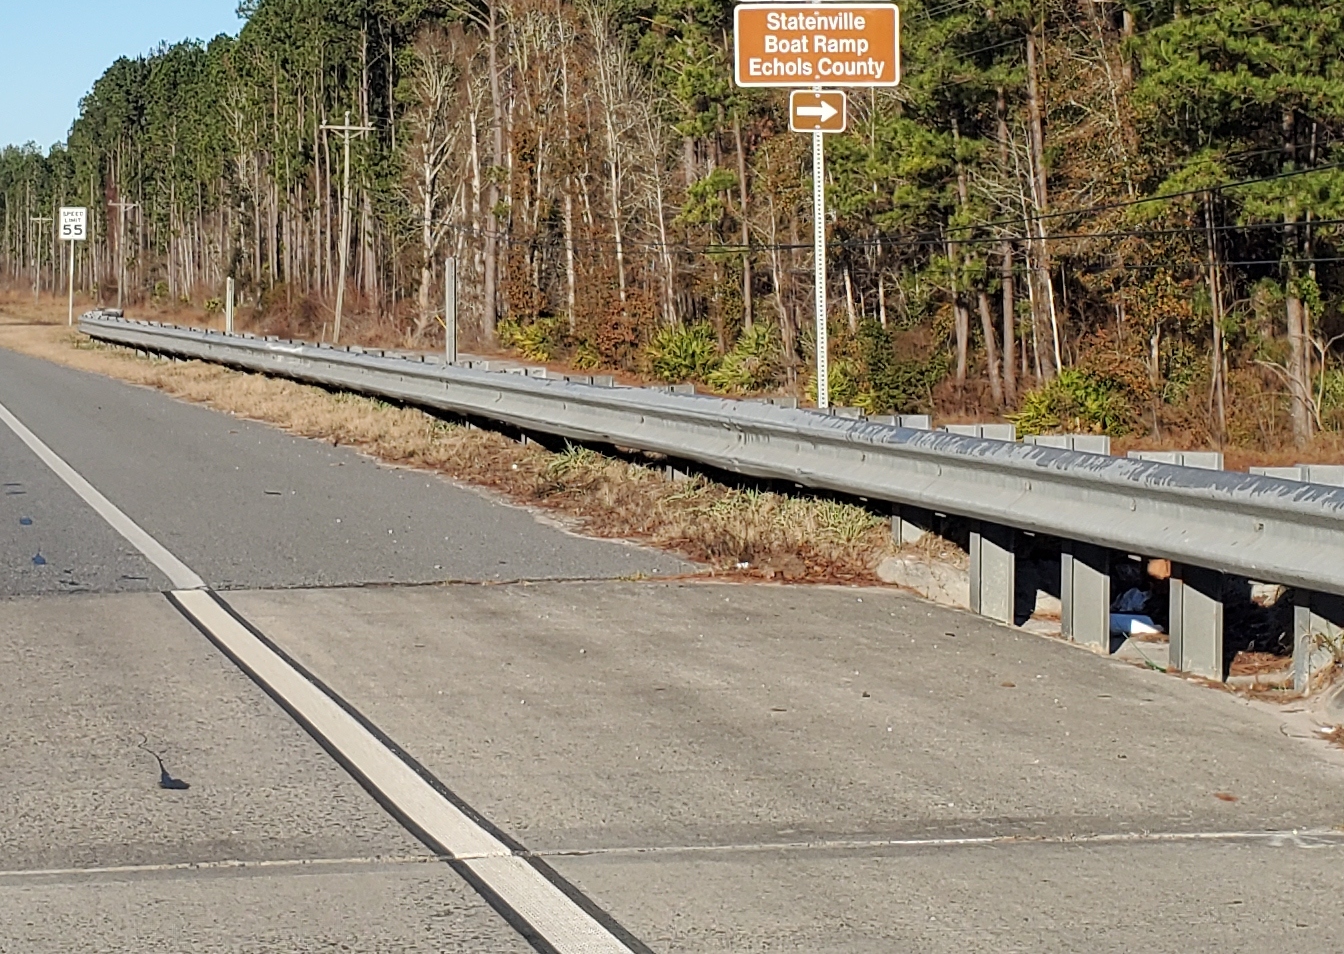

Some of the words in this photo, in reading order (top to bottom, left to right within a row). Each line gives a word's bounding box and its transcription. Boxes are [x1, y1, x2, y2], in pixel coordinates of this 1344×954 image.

[766, 11, 866, 31] Statenville
[764, 34, 809, 53] Boat
[814, 34, 869, 56] Ramp
[749, 57, 813, 76] Echols
[818, 57, 885, 79] County
[62, 224, 83, 236] 55
